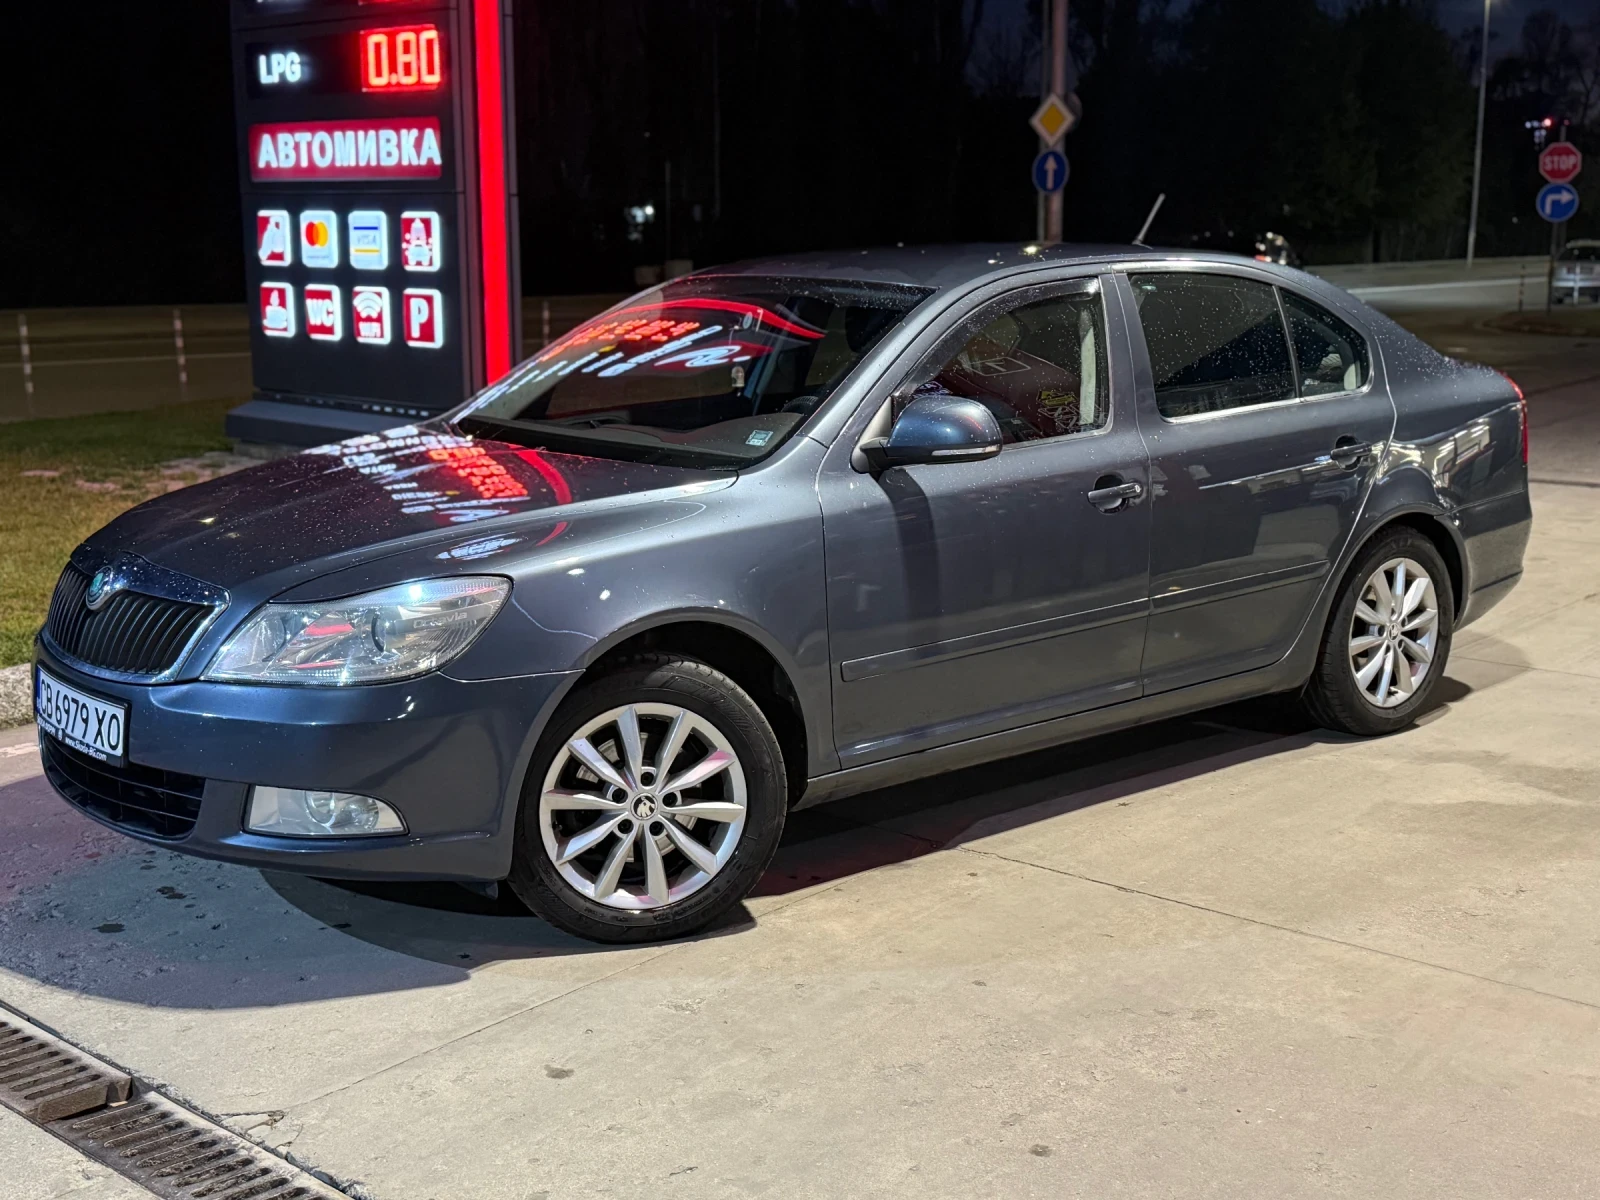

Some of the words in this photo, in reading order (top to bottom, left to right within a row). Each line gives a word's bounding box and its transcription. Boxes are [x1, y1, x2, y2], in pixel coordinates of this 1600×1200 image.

[258, 51, 301, 84] LPG
[366, 29, 442, 87] 0.80
[257, 127, 442, 169] АВТОМИВКА
[1543, 154, 1577, 171] STOP
[306, 298, 334, 327] WC
[409, 297, 429, 338] P
[413, 612, 468, 629] Octavia
